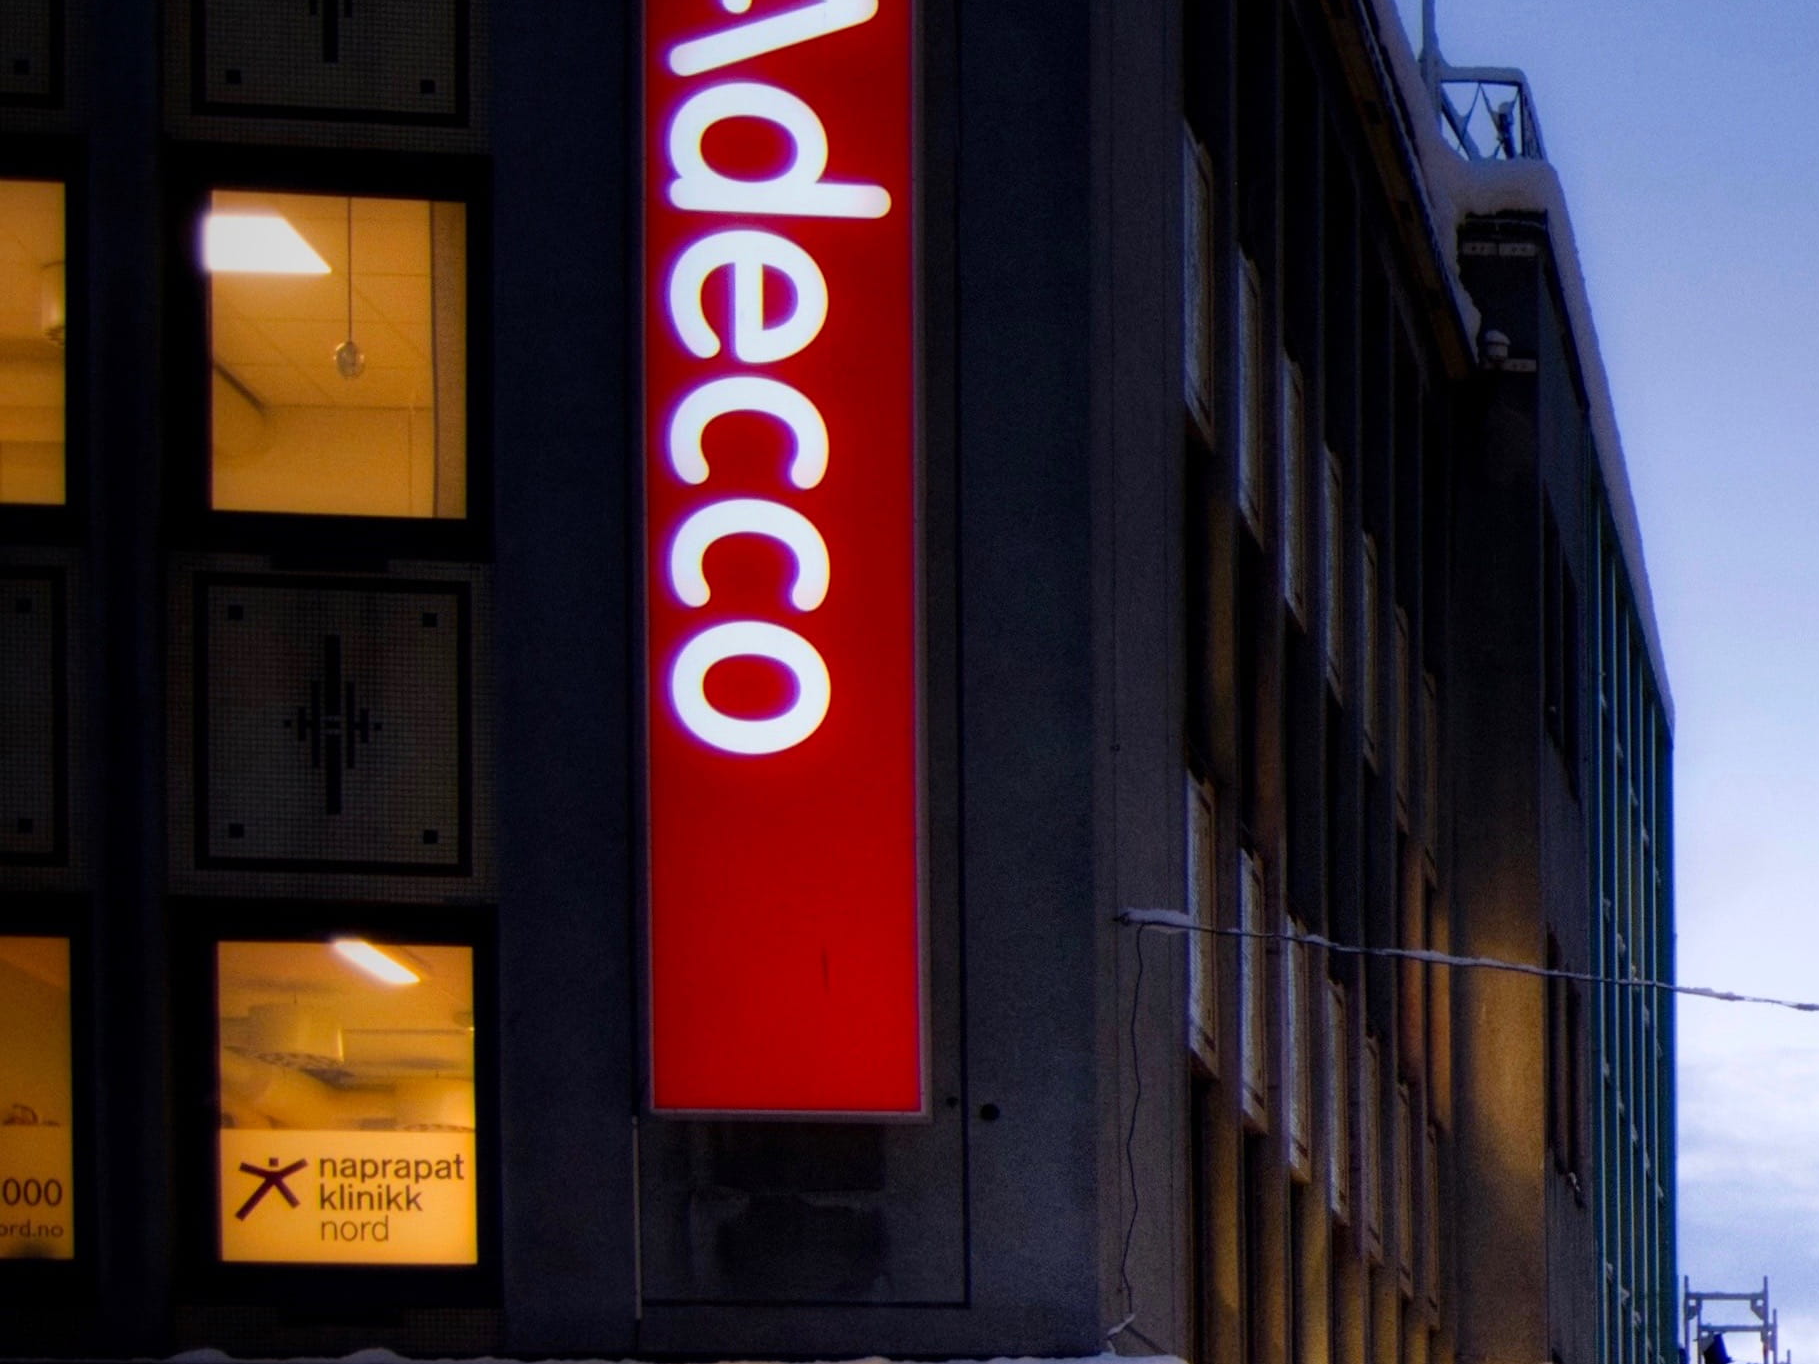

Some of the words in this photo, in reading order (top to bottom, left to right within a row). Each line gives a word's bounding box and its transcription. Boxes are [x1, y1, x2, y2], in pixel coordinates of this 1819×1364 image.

[319, 1154, 465, 1186] naprapat
[320, 1185, 423, 1212] klinikk
[320, 1214, 390, 1242] nord
